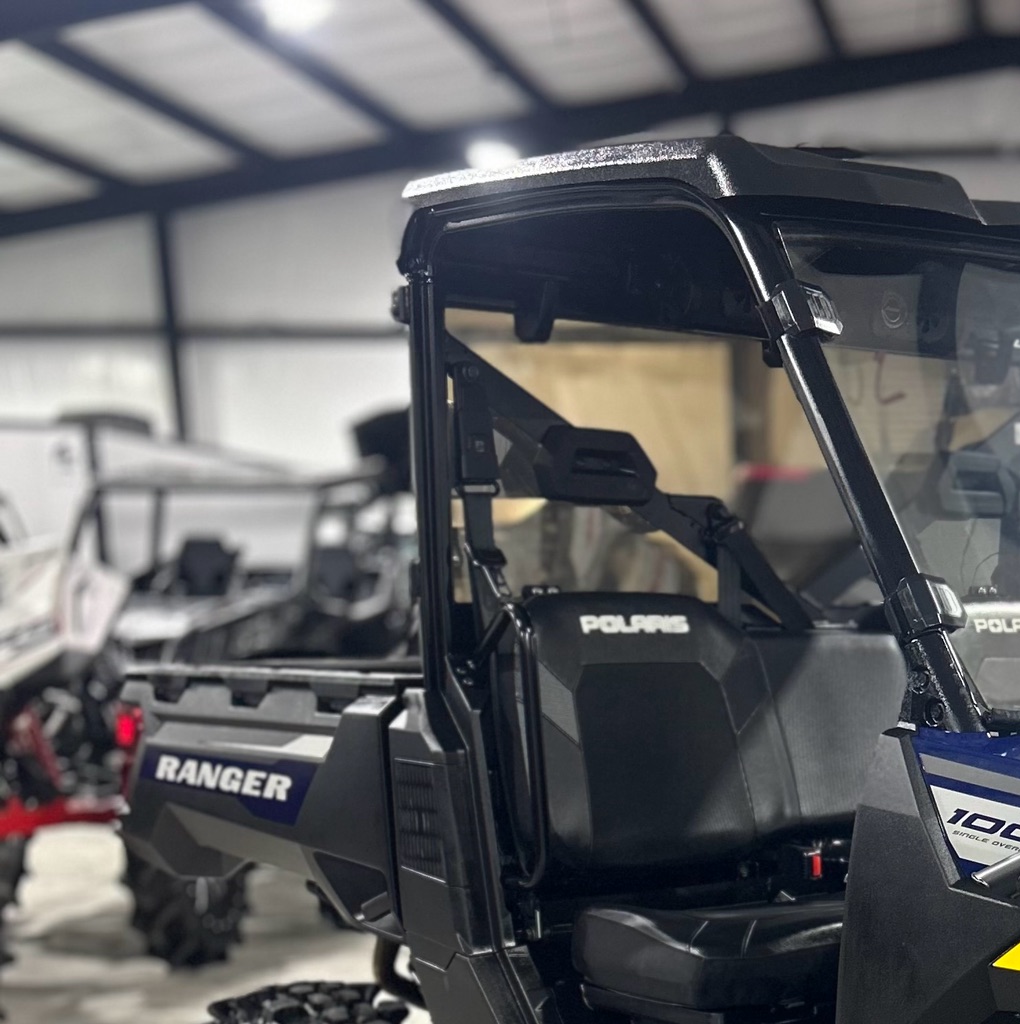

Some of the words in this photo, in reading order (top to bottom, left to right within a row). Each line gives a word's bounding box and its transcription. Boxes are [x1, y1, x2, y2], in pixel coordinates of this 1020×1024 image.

[579, 614, 690, 634] POLARIS
[154, 754, 293, 802] RANGER
[952, 830, 990, 843] SINGLE
